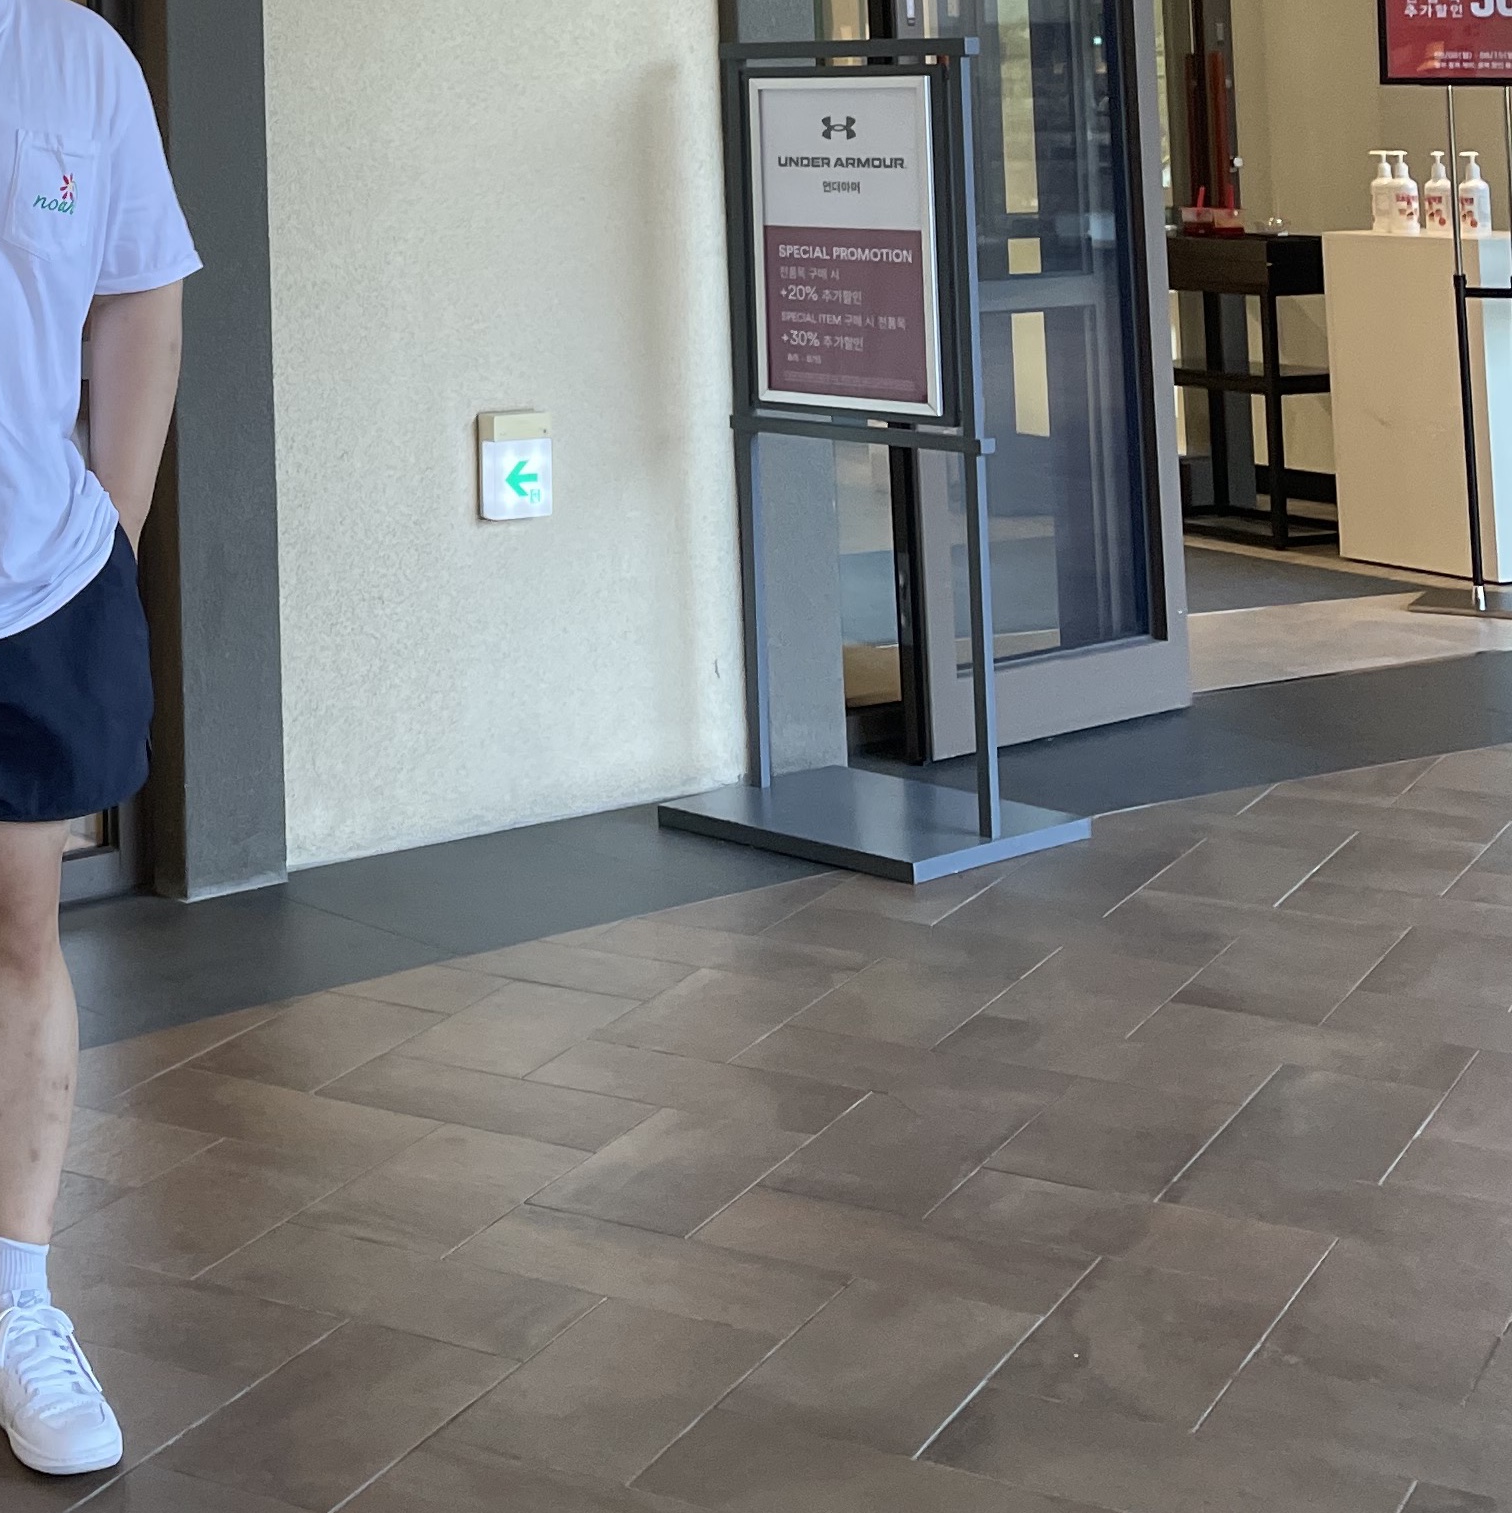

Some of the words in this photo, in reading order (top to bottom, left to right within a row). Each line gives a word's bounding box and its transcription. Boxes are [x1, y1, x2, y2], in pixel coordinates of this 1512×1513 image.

[777, 156, 831, 168] UNDER
[834, 157, 905, 169] ARMOUR
[778, 244, 830, 260] SPECIAL
[832, 246, 913, 264] PROMOTION
[780, 284, 818, 301] +20%
[781, 311, 816, 324] SPECIAL
[818, 314, 841, 325] ITEM
[781, 330, 820, 347] +30%
